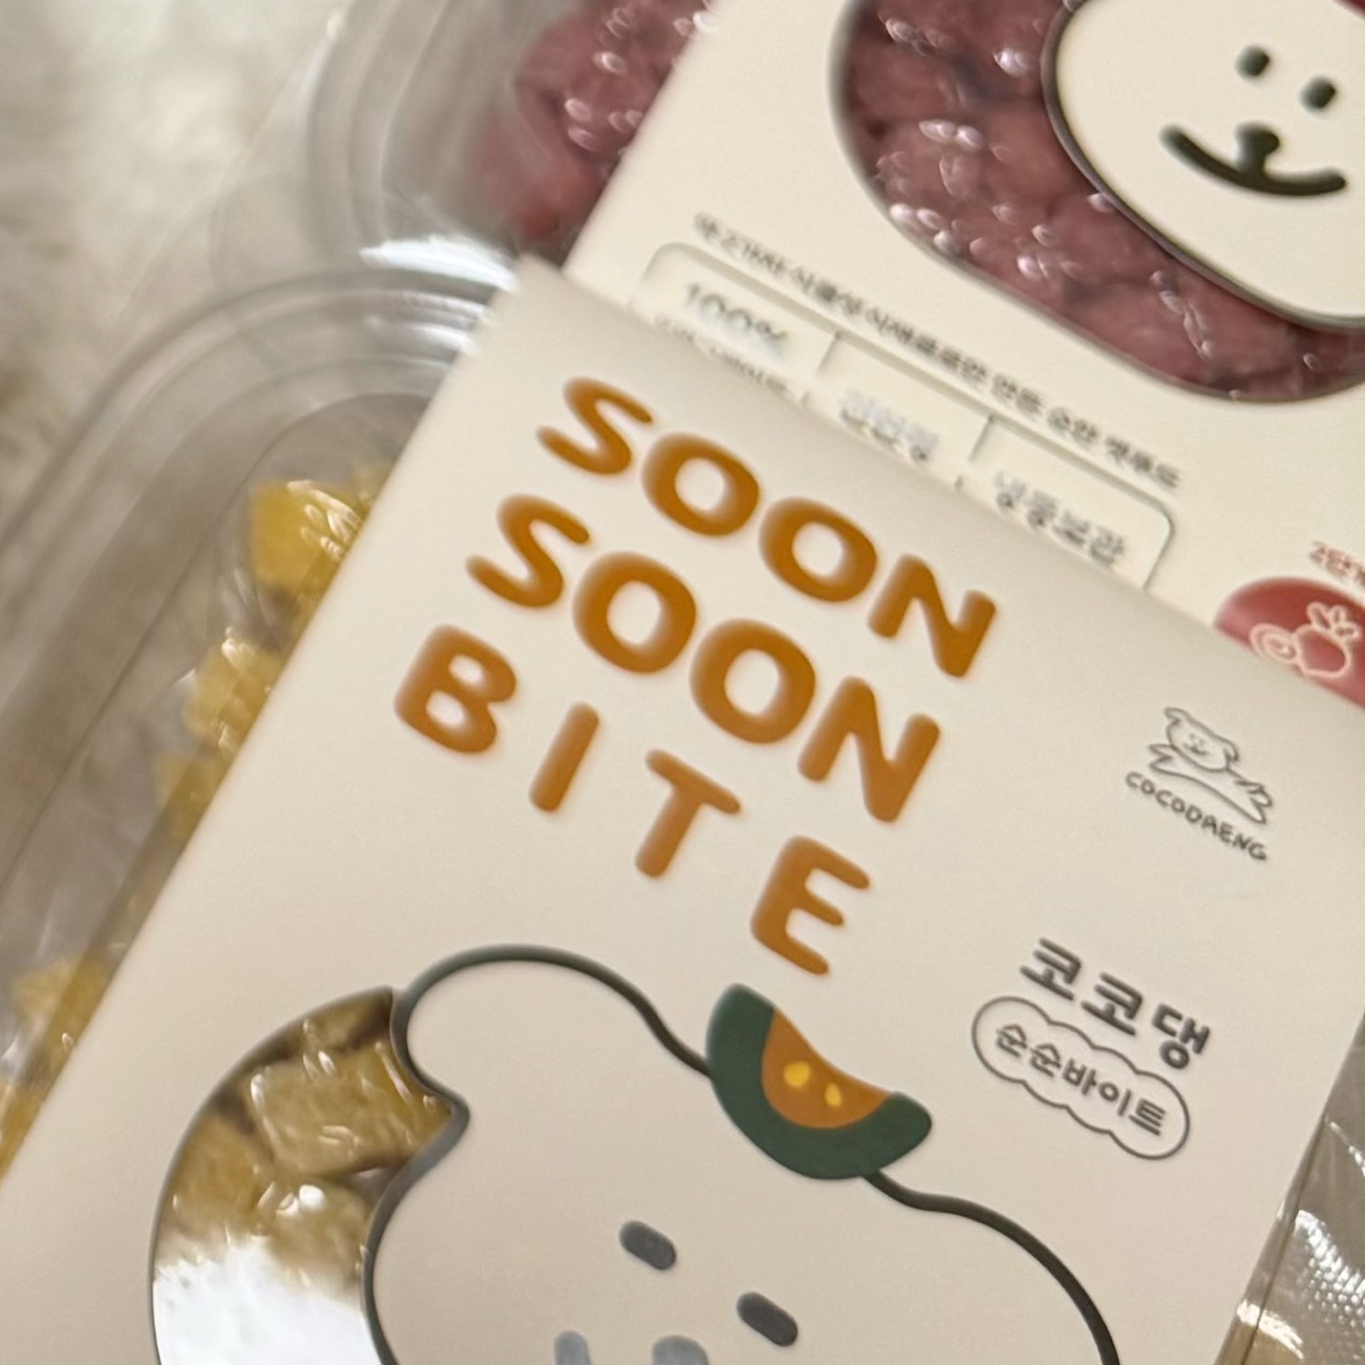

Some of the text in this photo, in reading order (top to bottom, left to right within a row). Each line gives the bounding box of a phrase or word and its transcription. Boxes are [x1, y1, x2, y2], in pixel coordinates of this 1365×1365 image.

[536, 376, 998, 678] SOON
[465, 493, 941, 823] SOON
[393, 624, 871, 976] BITE
[1125, 770, 1268, 862] COCODAENG
[995, 1023, 1167, 1136] 순순바이트
[1019, 936, 1210, 1070] 코코댕
